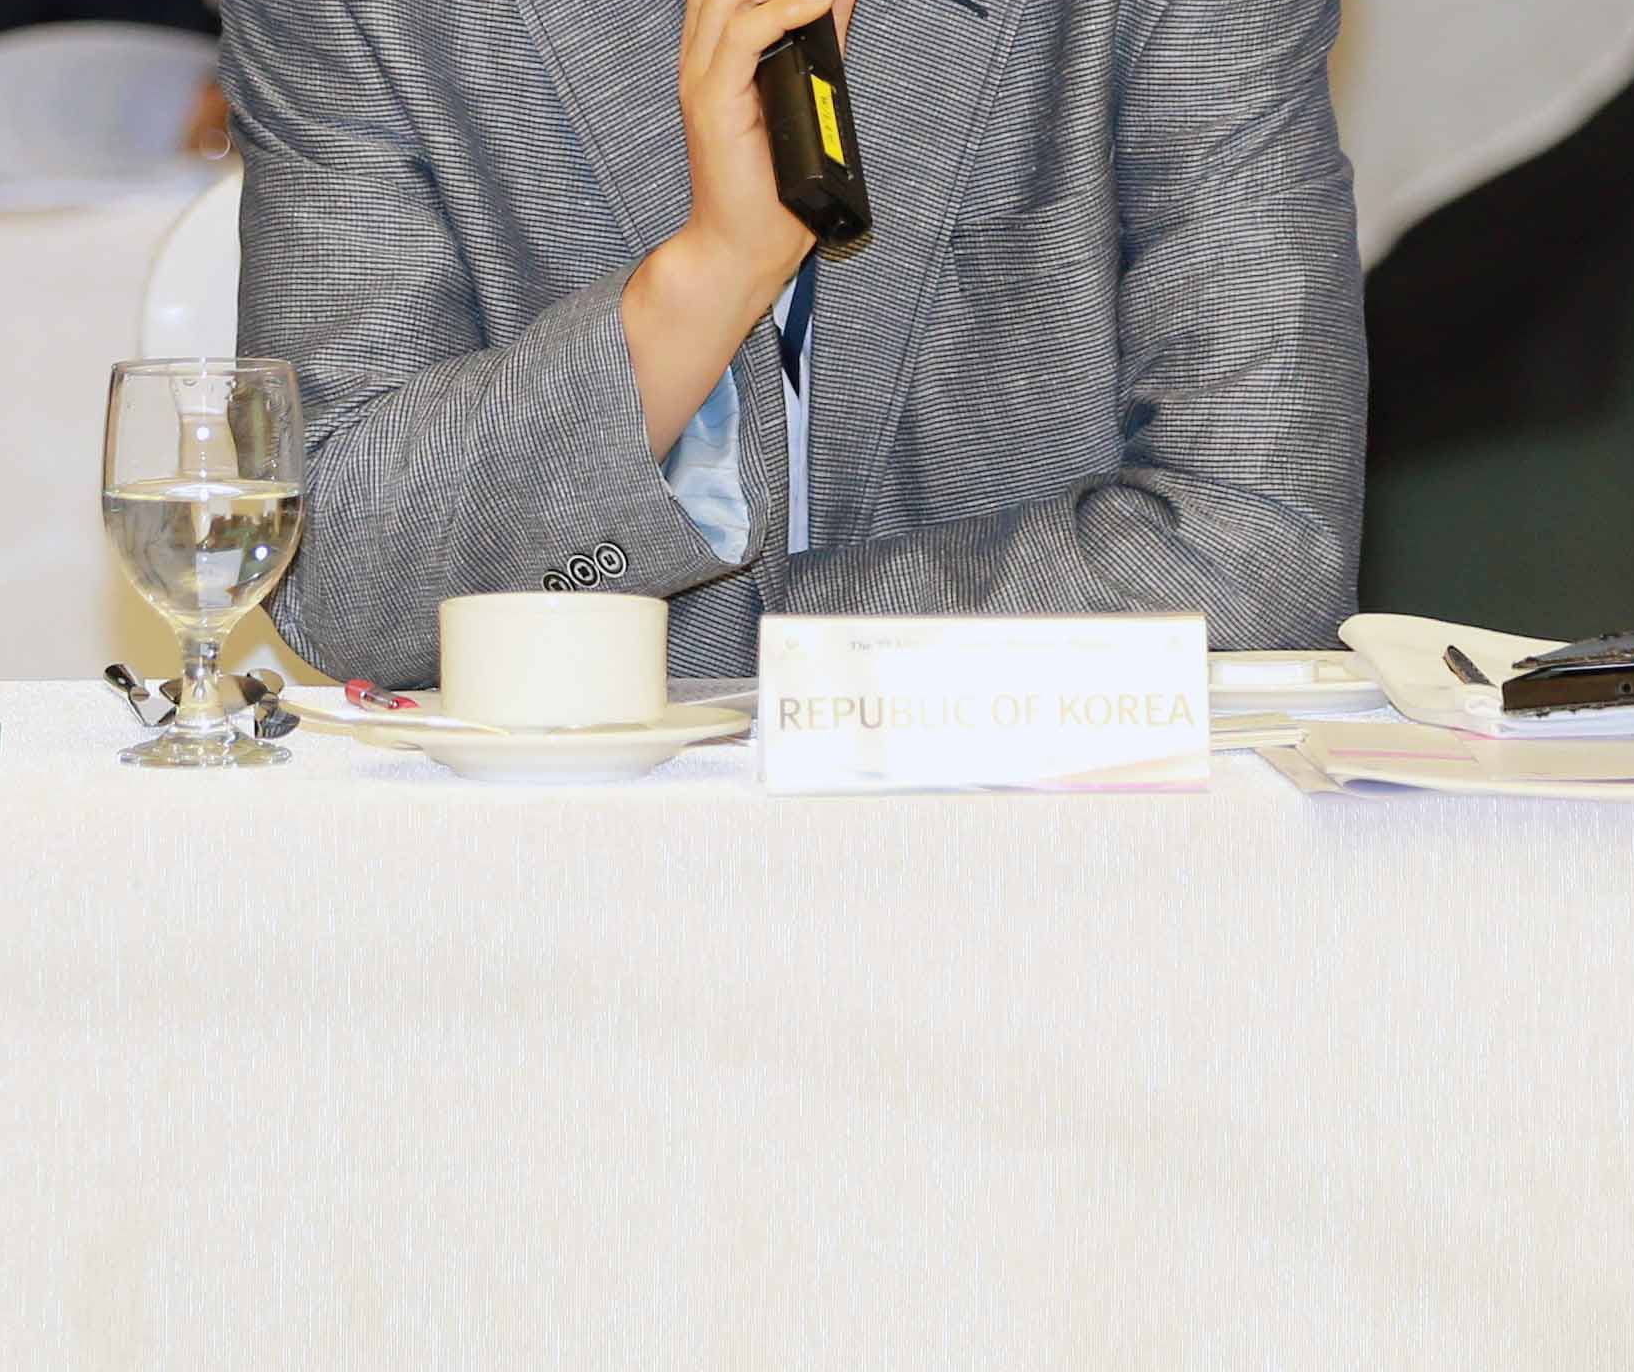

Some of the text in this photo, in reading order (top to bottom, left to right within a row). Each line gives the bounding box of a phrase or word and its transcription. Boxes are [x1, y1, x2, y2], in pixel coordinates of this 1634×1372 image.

[778, 692, 1195, 730] REPUBLIC OF KOREA
